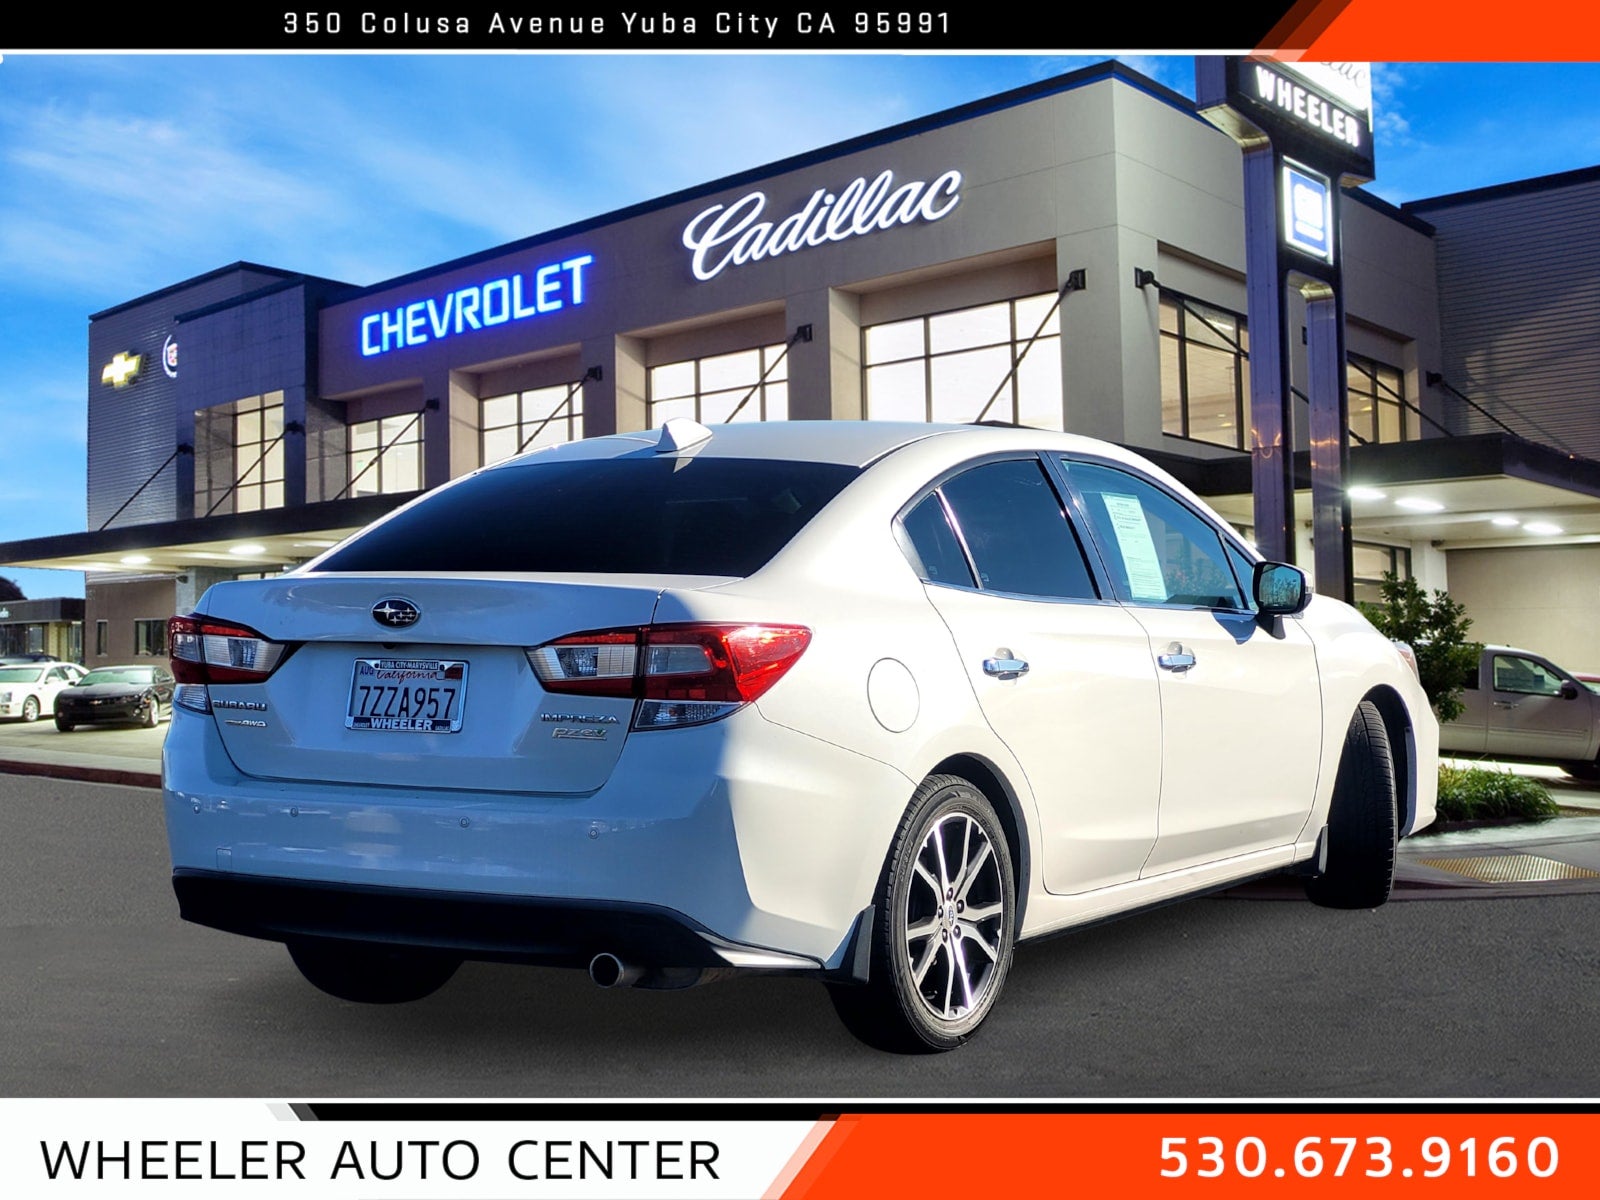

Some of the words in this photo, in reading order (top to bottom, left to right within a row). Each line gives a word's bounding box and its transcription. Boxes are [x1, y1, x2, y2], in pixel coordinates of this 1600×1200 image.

[1255, 65, 1360, 147] WHEELER
[682, 169, 962, 281] Cadillac
[361, 254, 594, 357] CHEVROLET
[360, 665, 374, 676] AUG
[376, 669, 438, 684] California
[211, 699, 268, 711] SUBARU
[359, 685, 456, 719] 7ZZA957
[370, 716, 433, 731] WHEELER
[540, 712, 620, 724] IMPREZA
